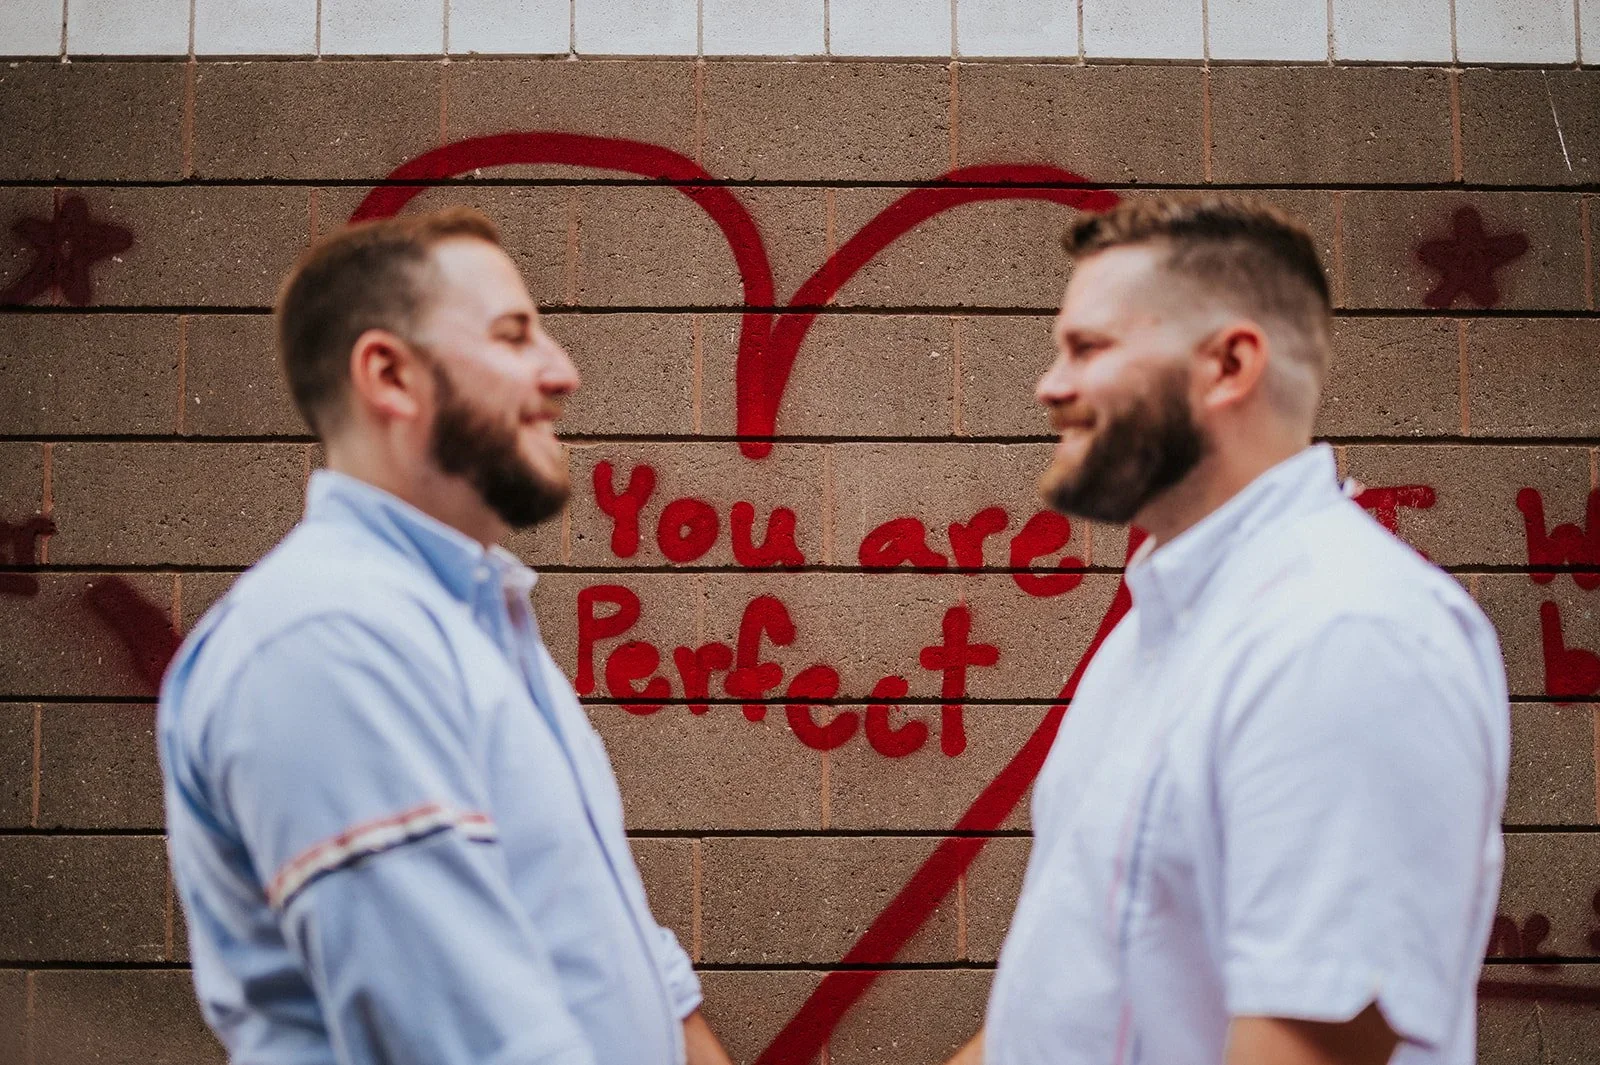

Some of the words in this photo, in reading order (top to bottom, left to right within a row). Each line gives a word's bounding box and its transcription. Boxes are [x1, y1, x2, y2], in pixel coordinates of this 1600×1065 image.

[592, 460, 805, 568] You
[858, 506, 1084, 597] are
[575, 584, 1000, 757] Perfect
